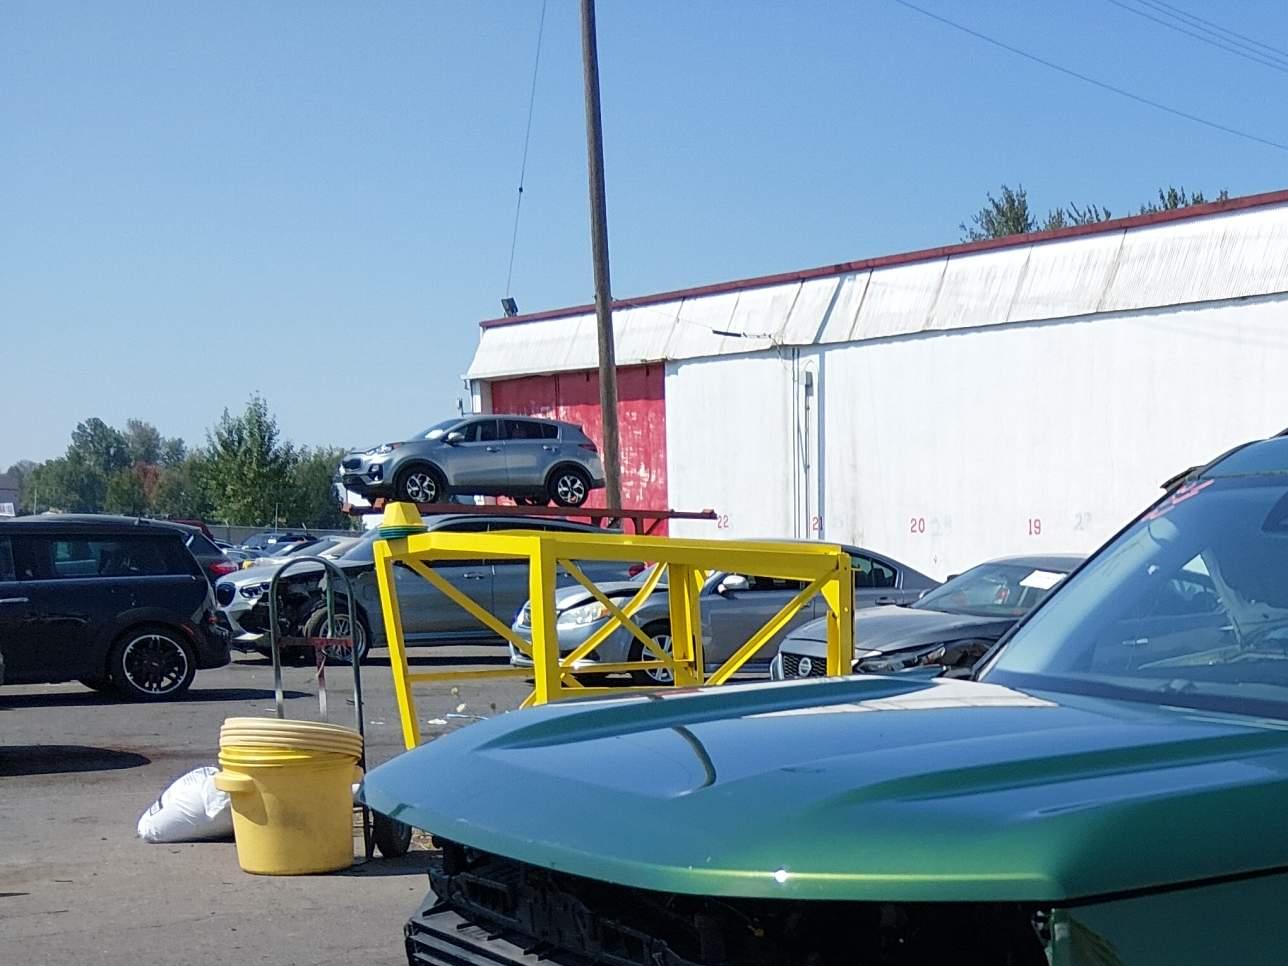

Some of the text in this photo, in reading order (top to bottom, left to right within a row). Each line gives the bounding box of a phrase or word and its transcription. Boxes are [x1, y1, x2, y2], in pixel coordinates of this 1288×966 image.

[717, 514, 729, 529] 22
[812, 516, 823, 531] 21
[910, 518, 926, 533] 20
[1028, 517, 1042, 536] 19
